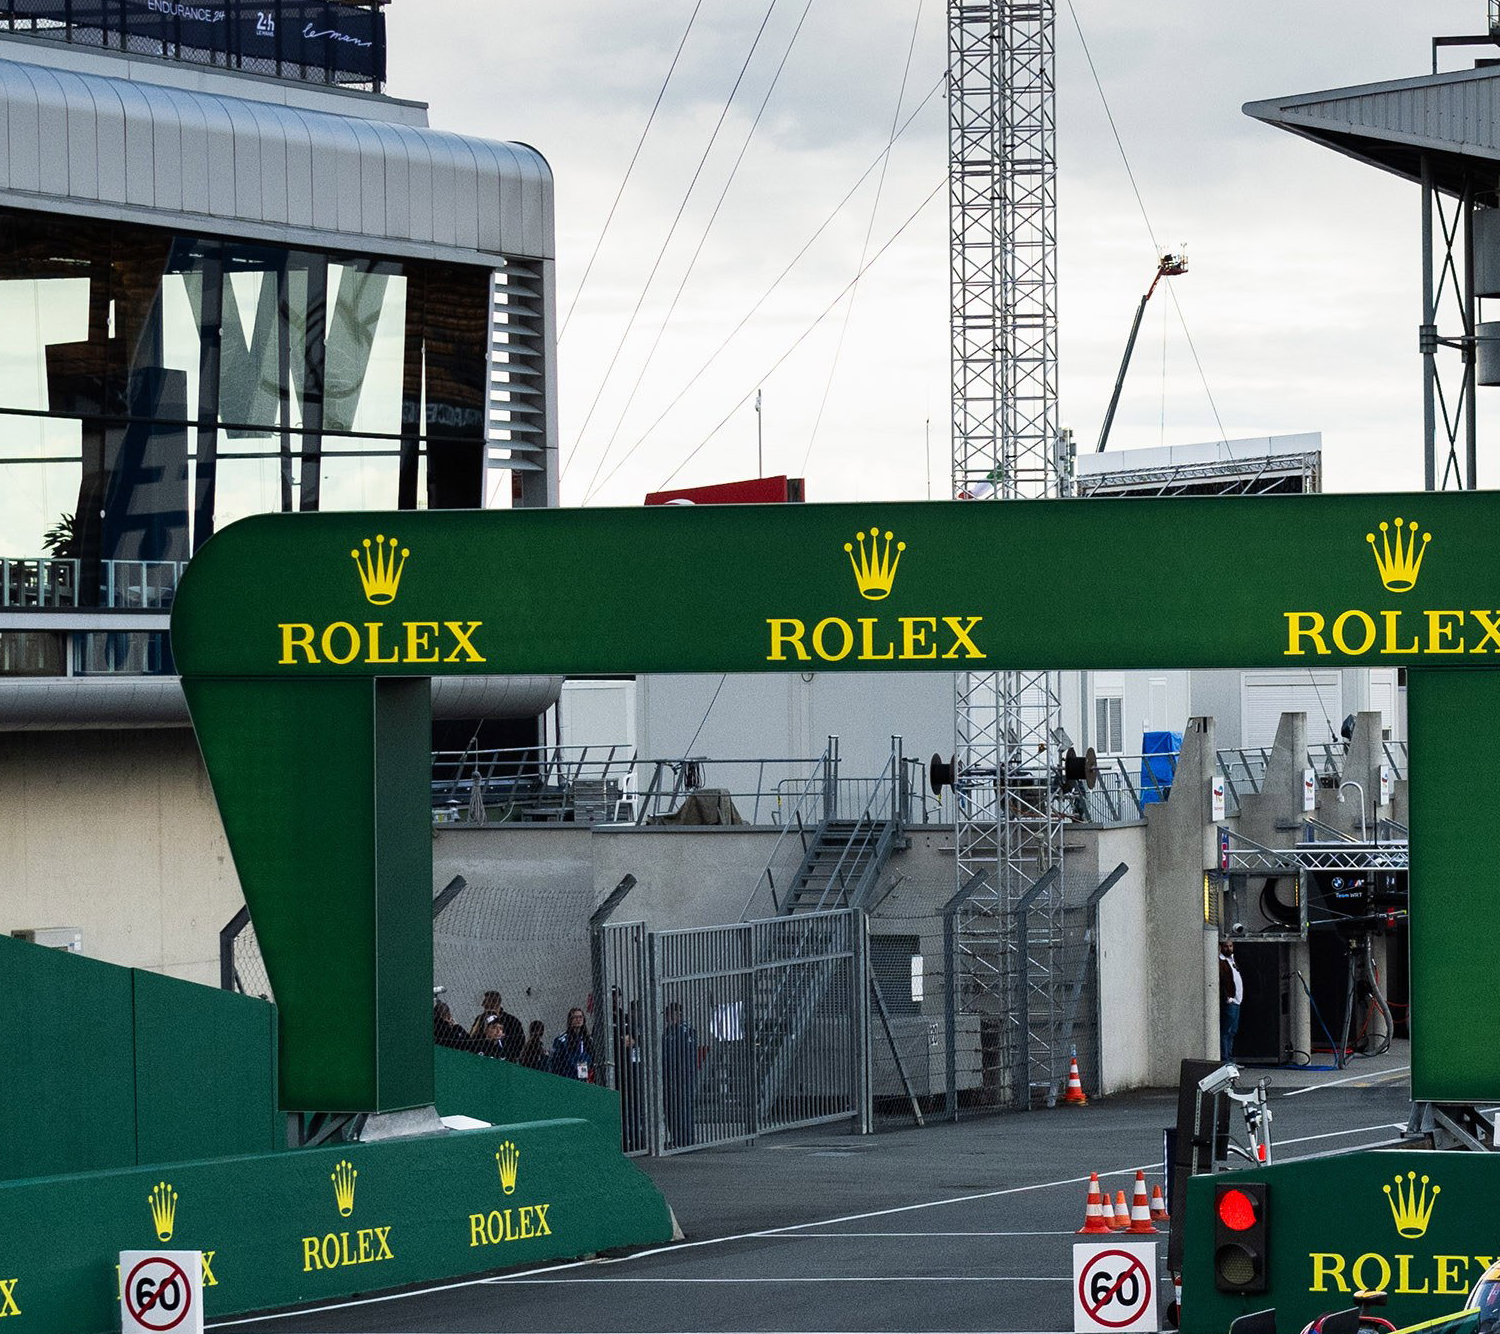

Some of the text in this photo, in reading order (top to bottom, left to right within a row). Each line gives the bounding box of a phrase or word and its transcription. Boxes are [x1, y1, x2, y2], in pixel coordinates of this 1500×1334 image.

[276, 620, 486, 667] ROLEX
[764, 614, 987, 663] ROLEX
[469, 1204, 553, 1247] ROLEX
[302, 1226, 394, 1271] ROLEX
[136, 1277, 180, 1311] 60
[1091, 1270, 1140, 1307] 60
